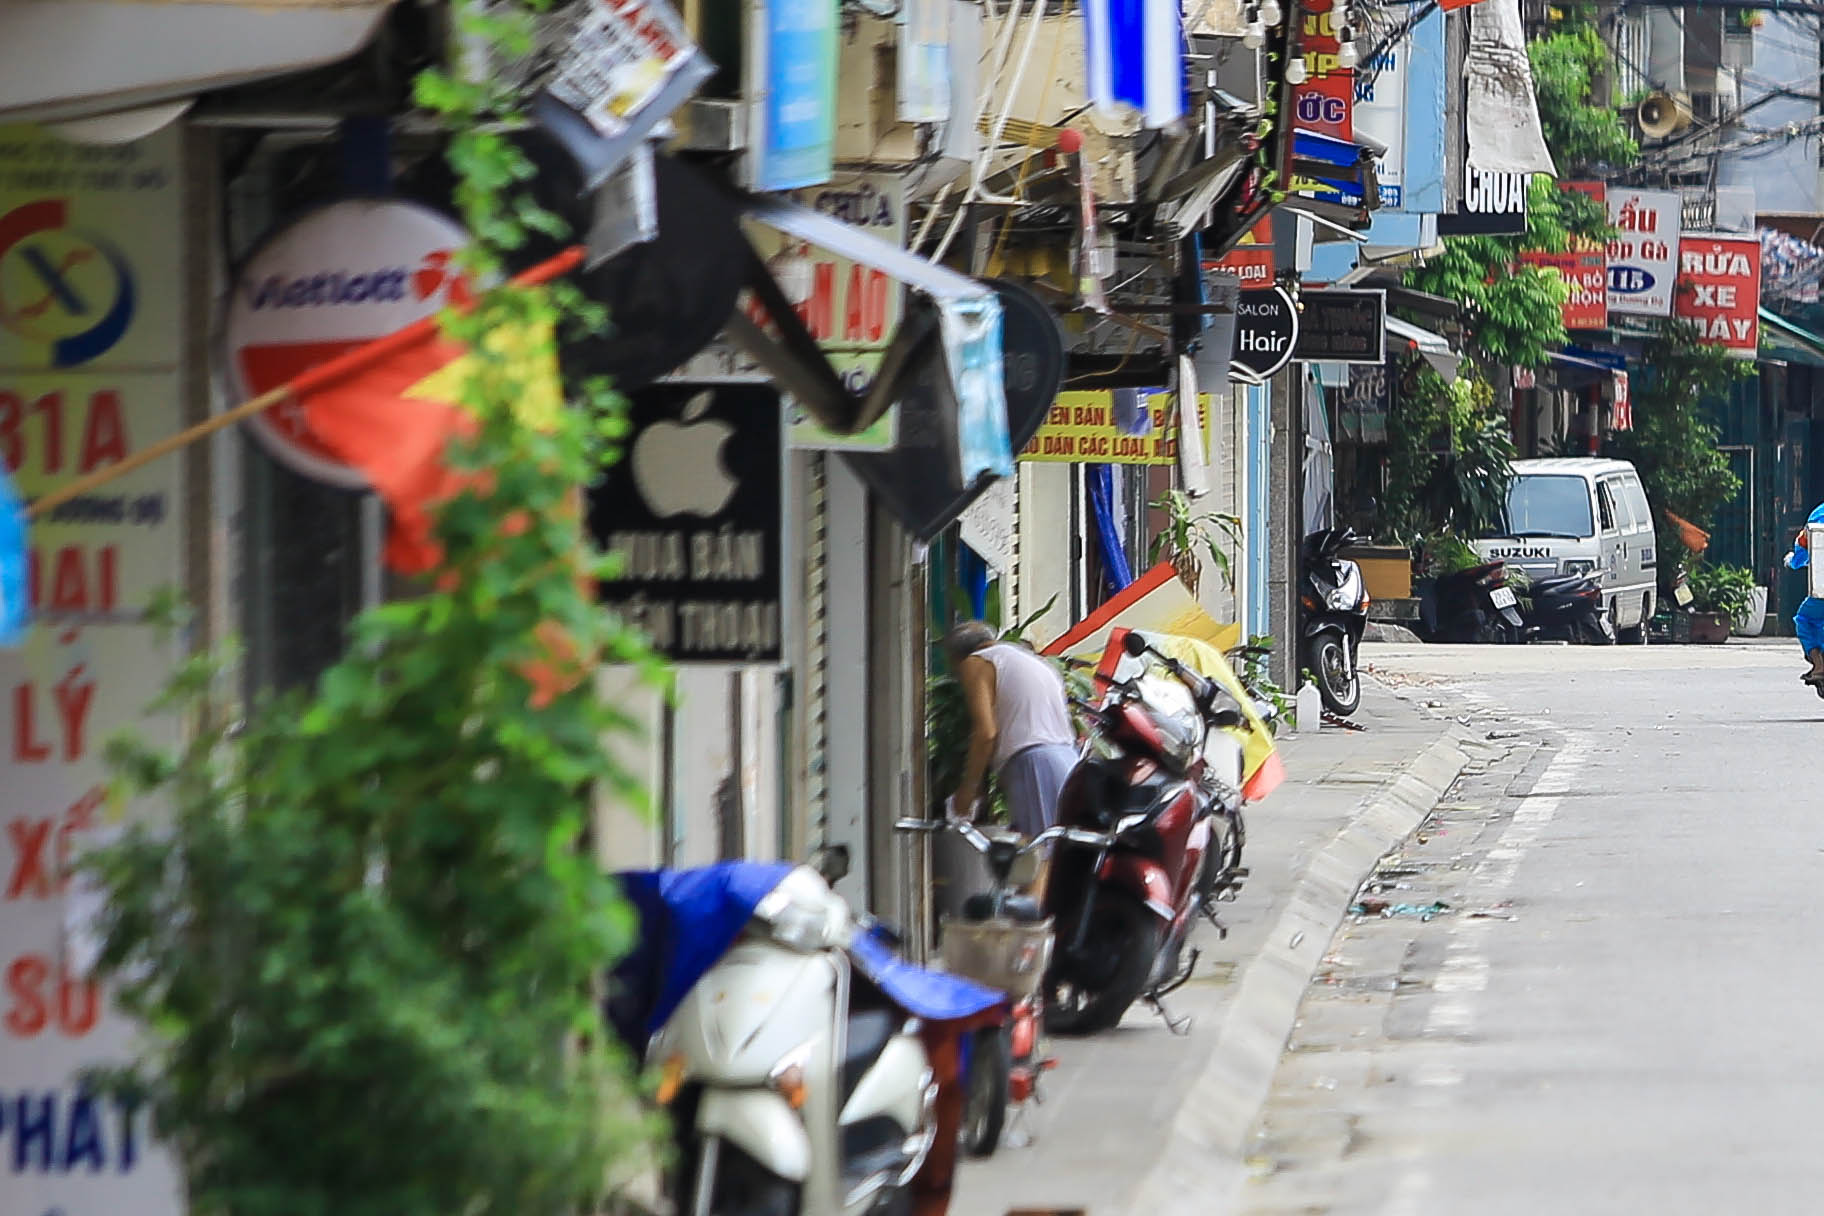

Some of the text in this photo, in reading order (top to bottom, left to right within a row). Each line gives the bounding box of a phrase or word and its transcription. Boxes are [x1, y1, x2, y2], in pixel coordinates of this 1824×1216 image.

[1682, 244, 1751, 277] RỬA
[1693, 285, 1737, 308] XE
[1238, 303, 1279, 316] SALON
[1240, 330, 1287, 352] Hair
[1079, 433, 1107, 455] CÁC
[1489, 547, 1551, 559] SUZUKI
[13, 661, 97, 764] LÝ
